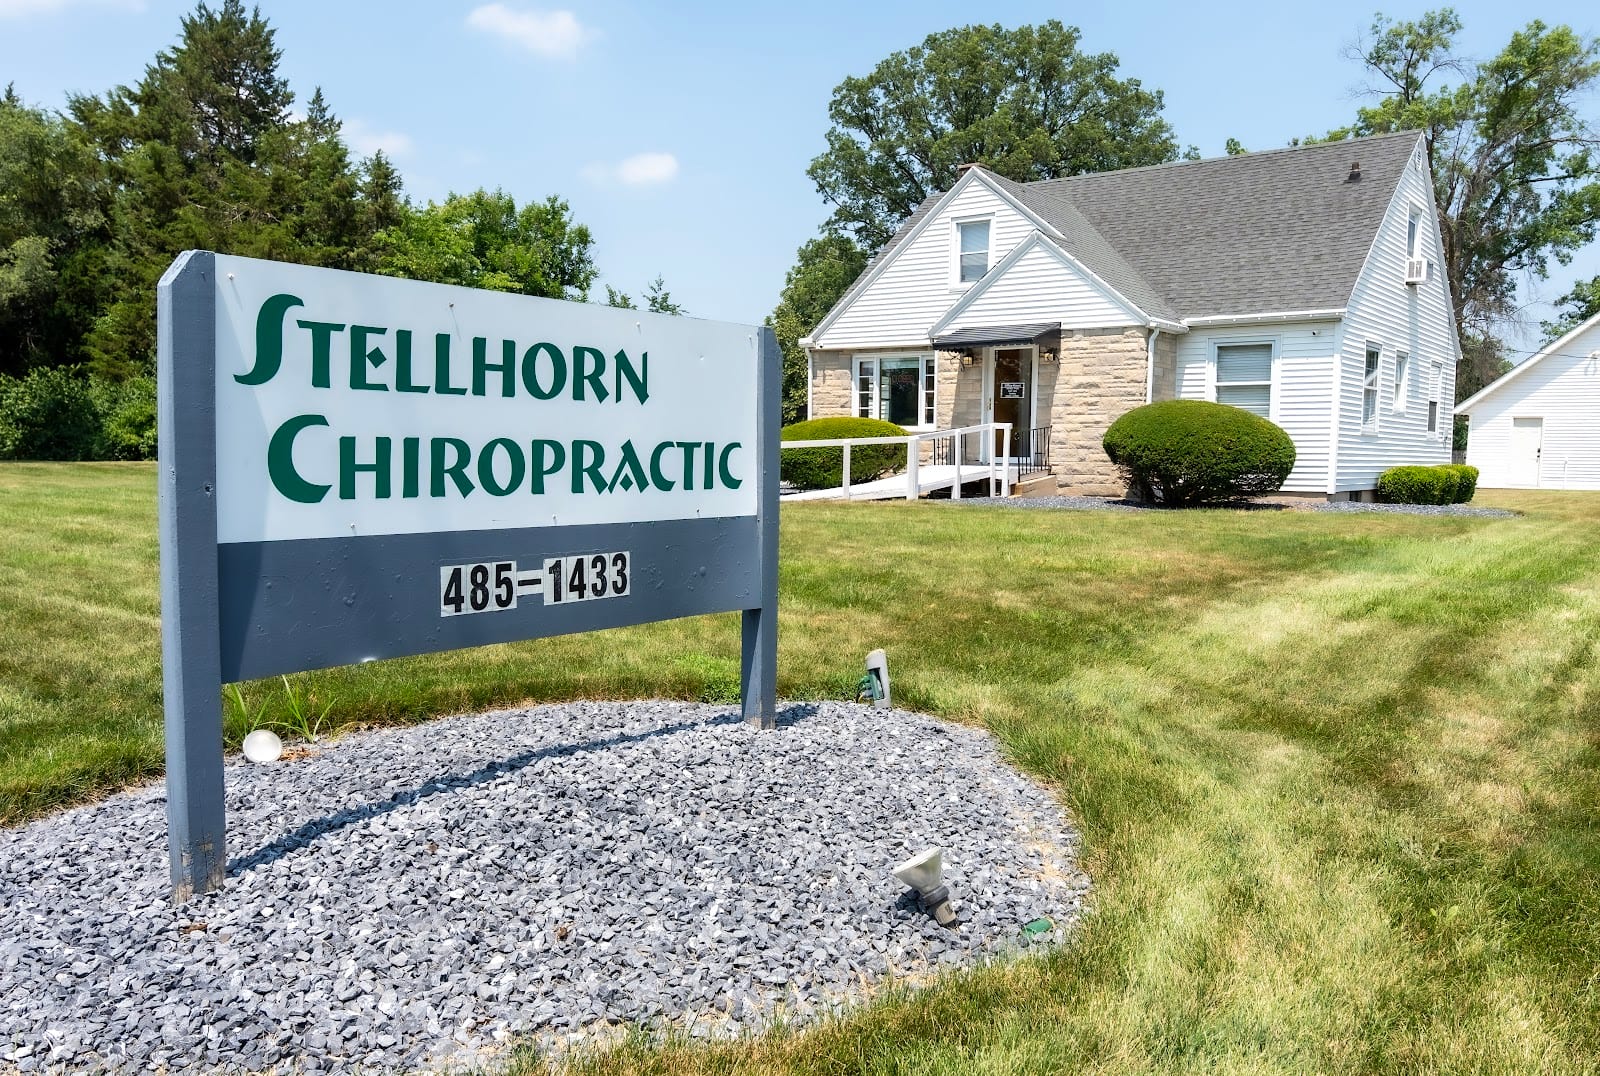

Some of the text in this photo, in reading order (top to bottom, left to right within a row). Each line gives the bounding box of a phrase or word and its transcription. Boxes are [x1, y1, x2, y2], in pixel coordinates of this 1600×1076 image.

[234, 294, 649, 404] STELLHORN
[268, 415, 742, 503] CHIROPRACTIC
[444, 553, 627, 612] 485-1433
